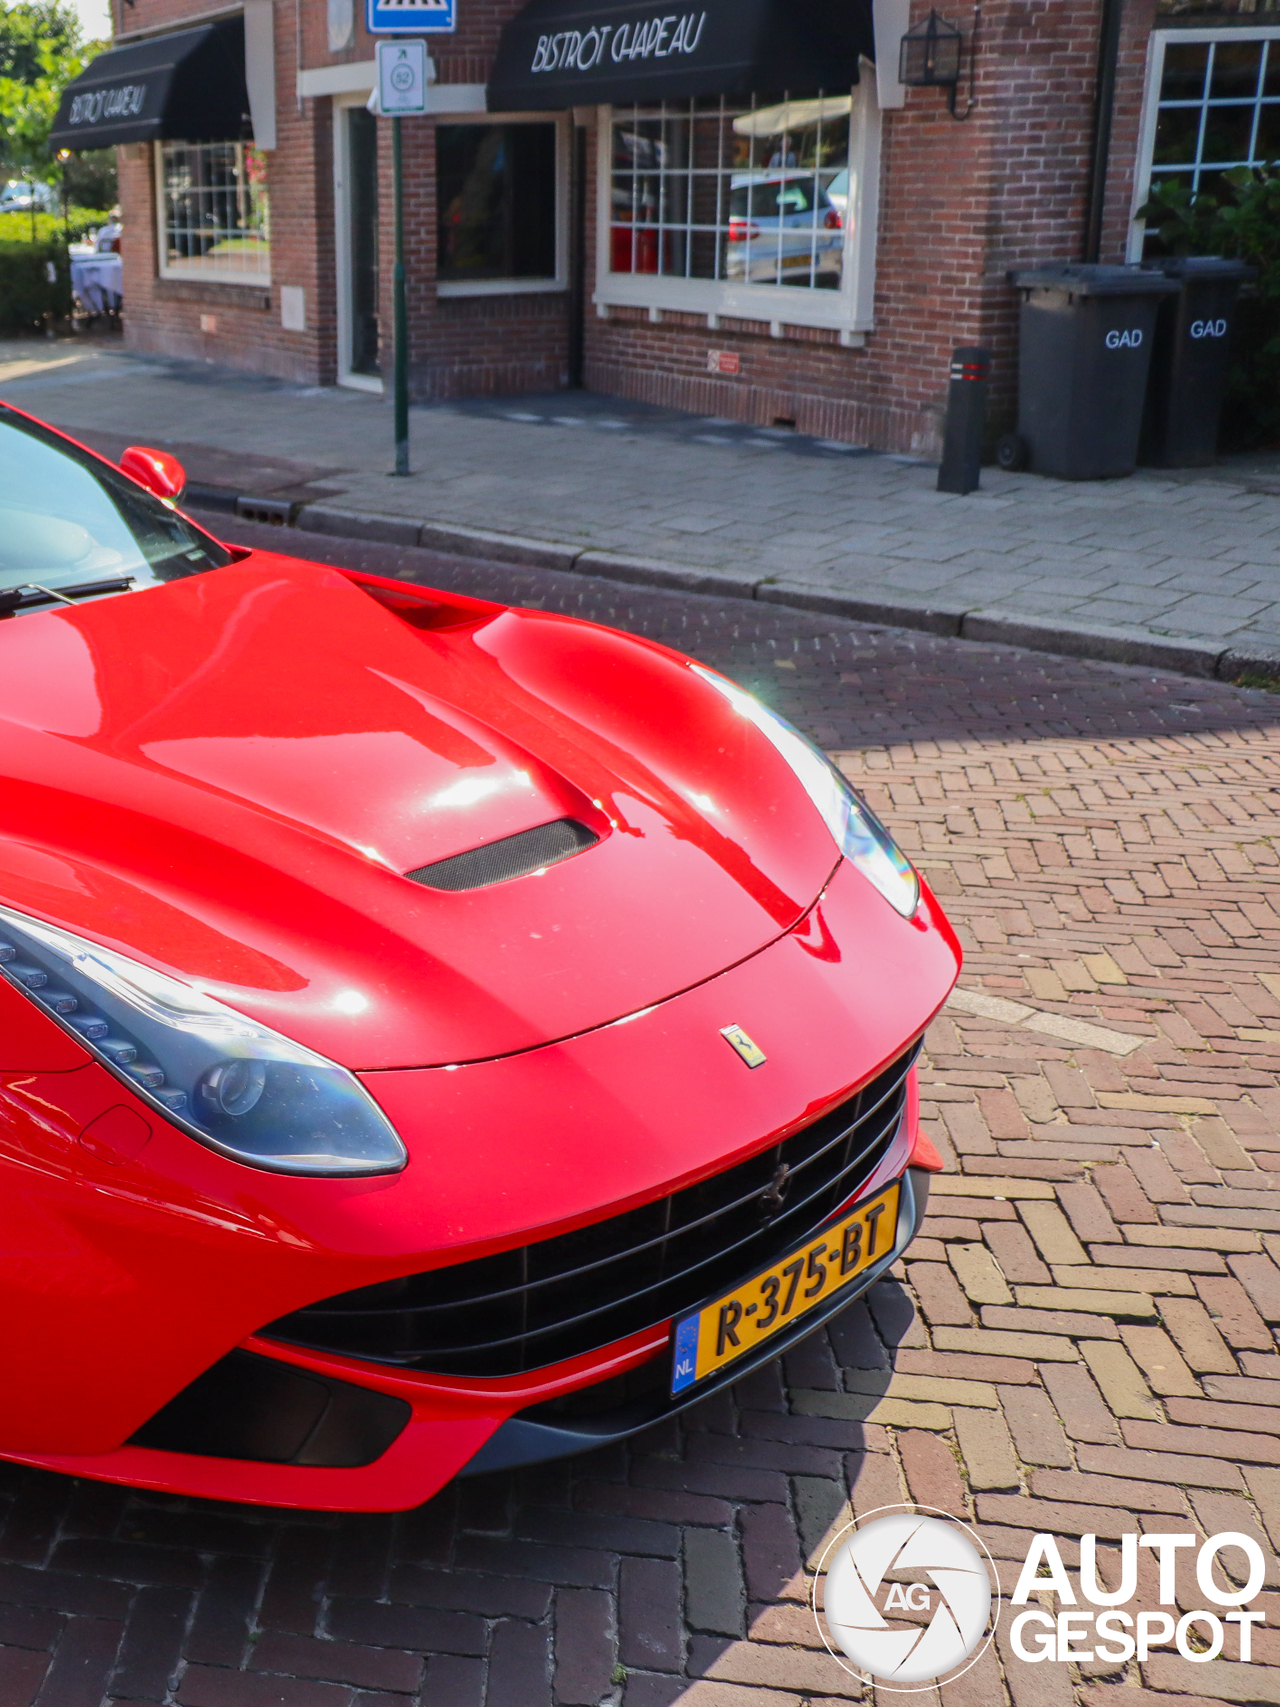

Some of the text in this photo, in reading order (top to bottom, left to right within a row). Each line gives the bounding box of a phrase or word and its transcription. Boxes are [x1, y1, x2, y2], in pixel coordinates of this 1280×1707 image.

[531, 11, 707, 73] BISTRÔT CHAPEAU
[1105, 329, 1143, 349] GAD
[1190, 319, 1227, 338] GAD
[715, 1203, 886, 1357] R-375-BT
[675, 1358, 694, 1379] NL
